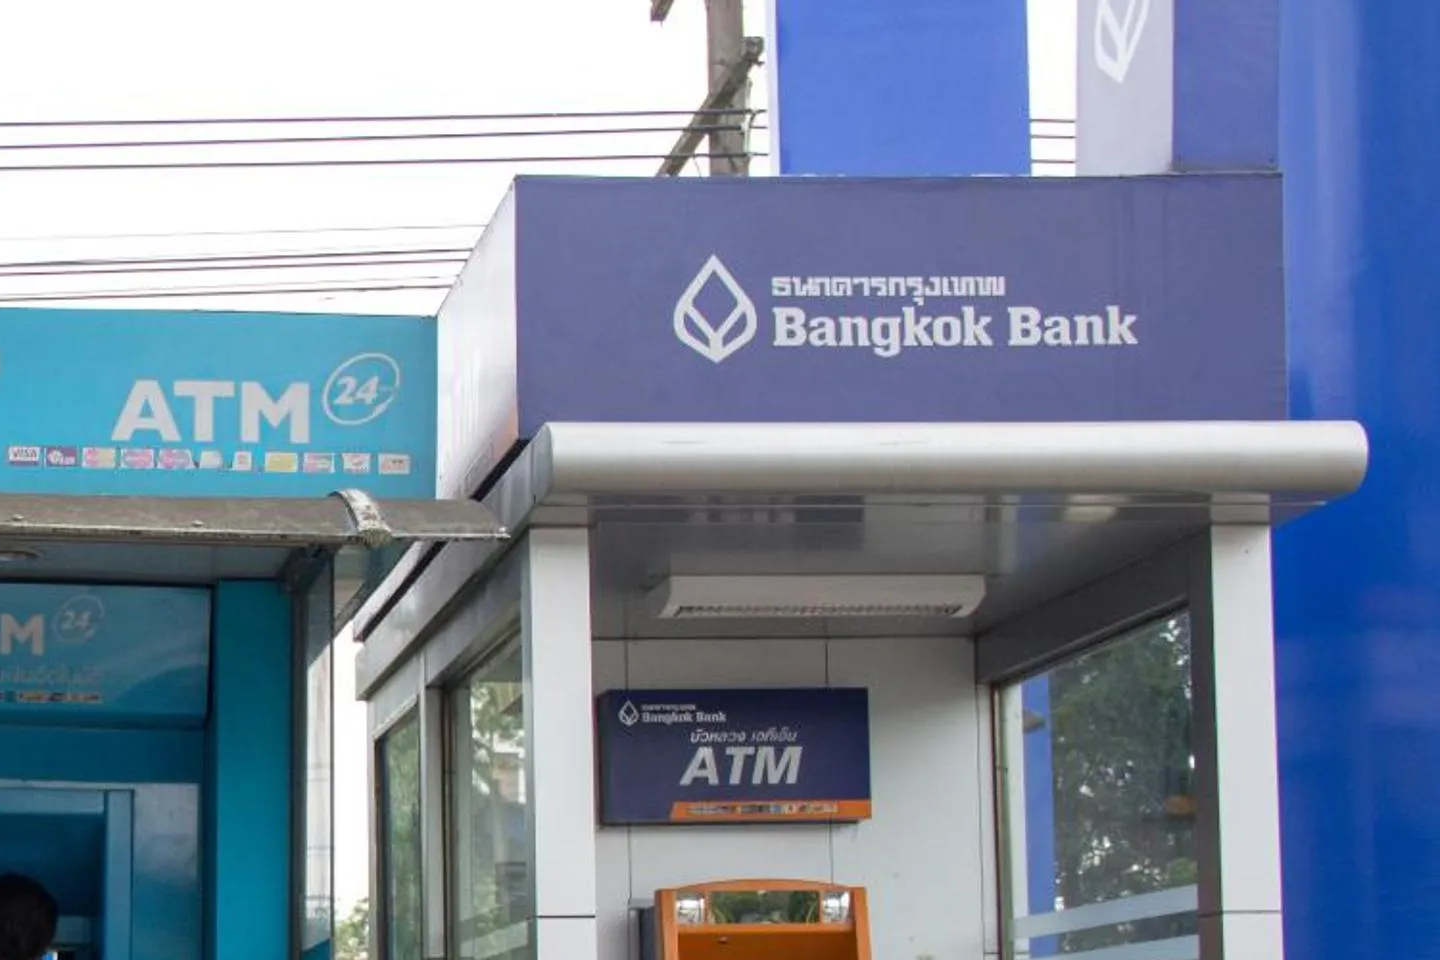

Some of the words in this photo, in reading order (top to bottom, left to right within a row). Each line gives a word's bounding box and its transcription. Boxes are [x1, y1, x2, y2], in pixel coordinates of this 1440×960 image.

[771, 275, 1007, 307] ธนาคารกรุงเทพ
[771, 306, 993, 358] Bangkok
[1008, 306, 1140, 347] Bank
[110, 379, 311, 444] ATM
[333, 375, 380, 405] 24
[641, 712, 694, 725] Bangkok
[696, 711, 727, 723] Bank
[679, 745, 803, 786] ATM
